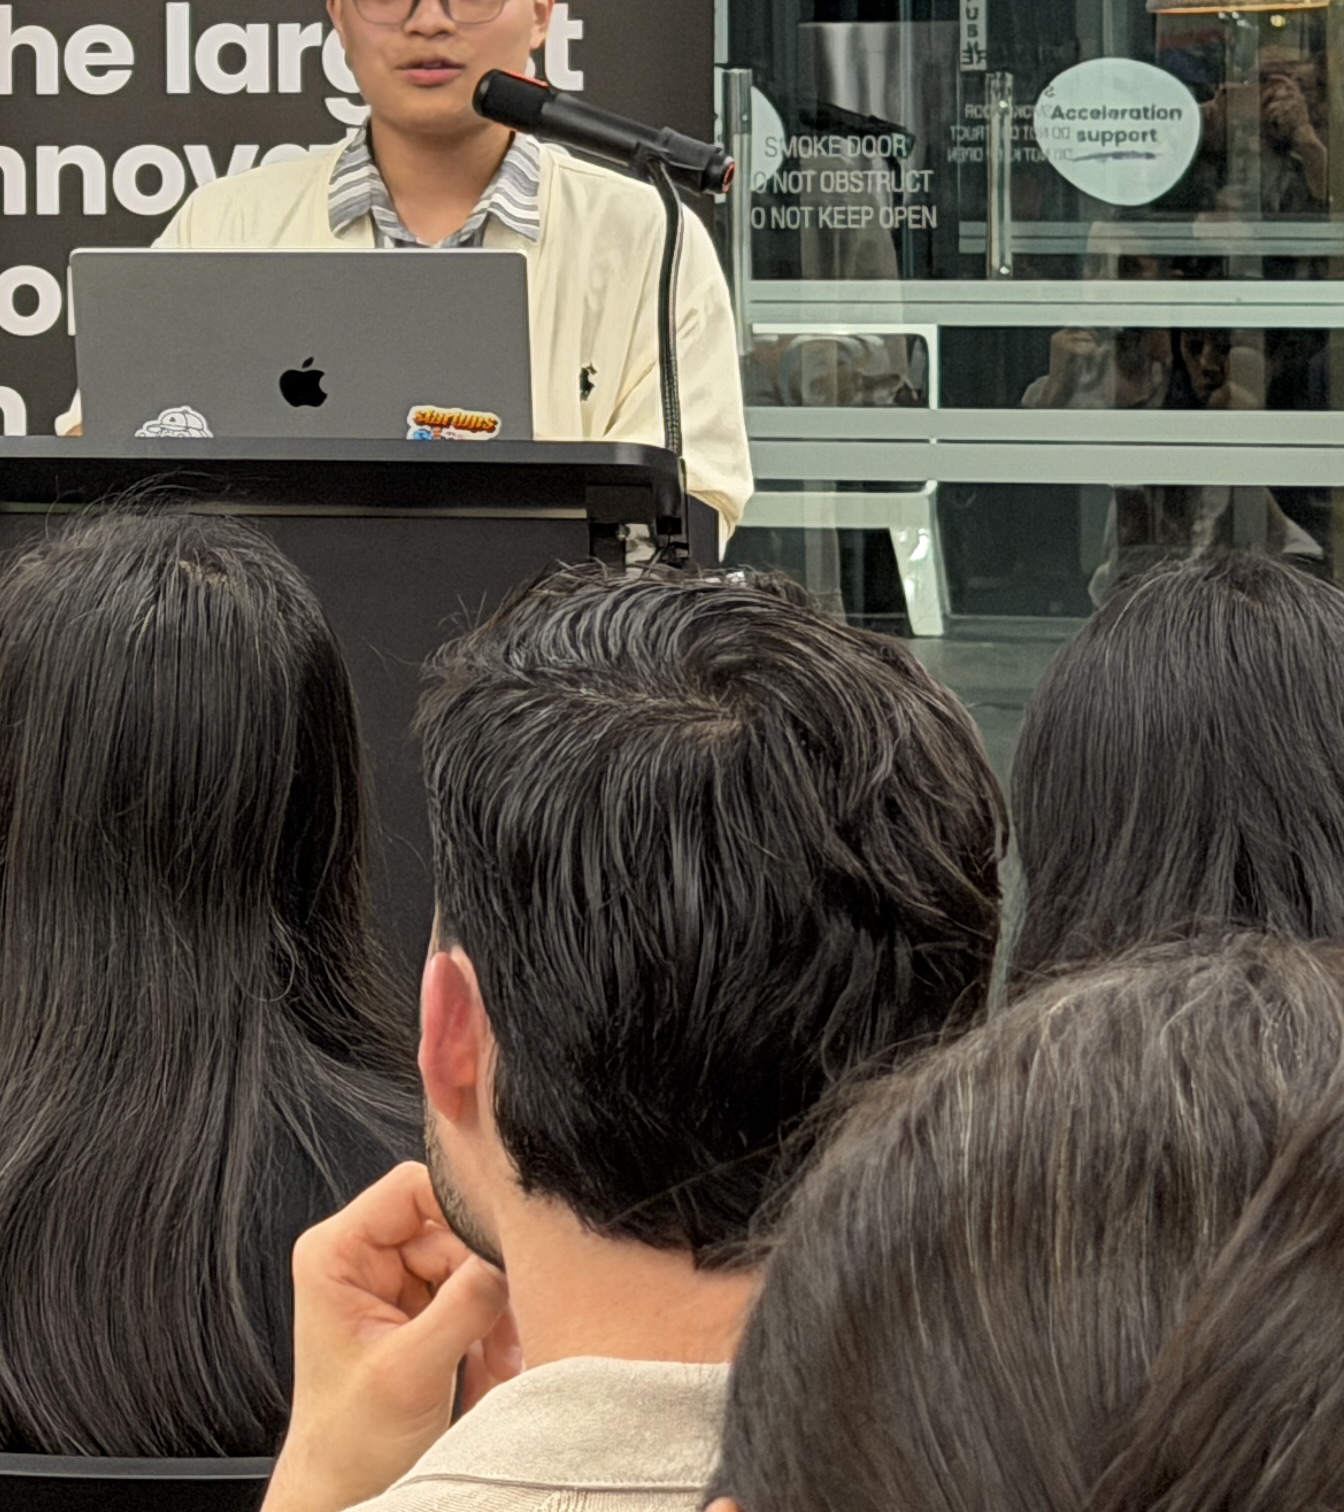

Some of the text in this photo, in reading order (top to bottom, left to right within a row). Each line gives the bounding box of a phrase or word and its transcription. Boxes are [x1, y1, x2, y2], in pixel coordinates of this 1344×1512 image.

[1050, 103, 1183, 122] Acceleration
[764, 134, 908, 159] SMOKE DOOR
[1076, 127, 1158, 147] support
[773, 170, 817, 194] NOT
[820, 169, 934, 194] OBSTRUCT
[771, 206, 814, 230] NOT
[819, 206, 874, 230] KEEP
[879, 205, 938, 229] OPEN
